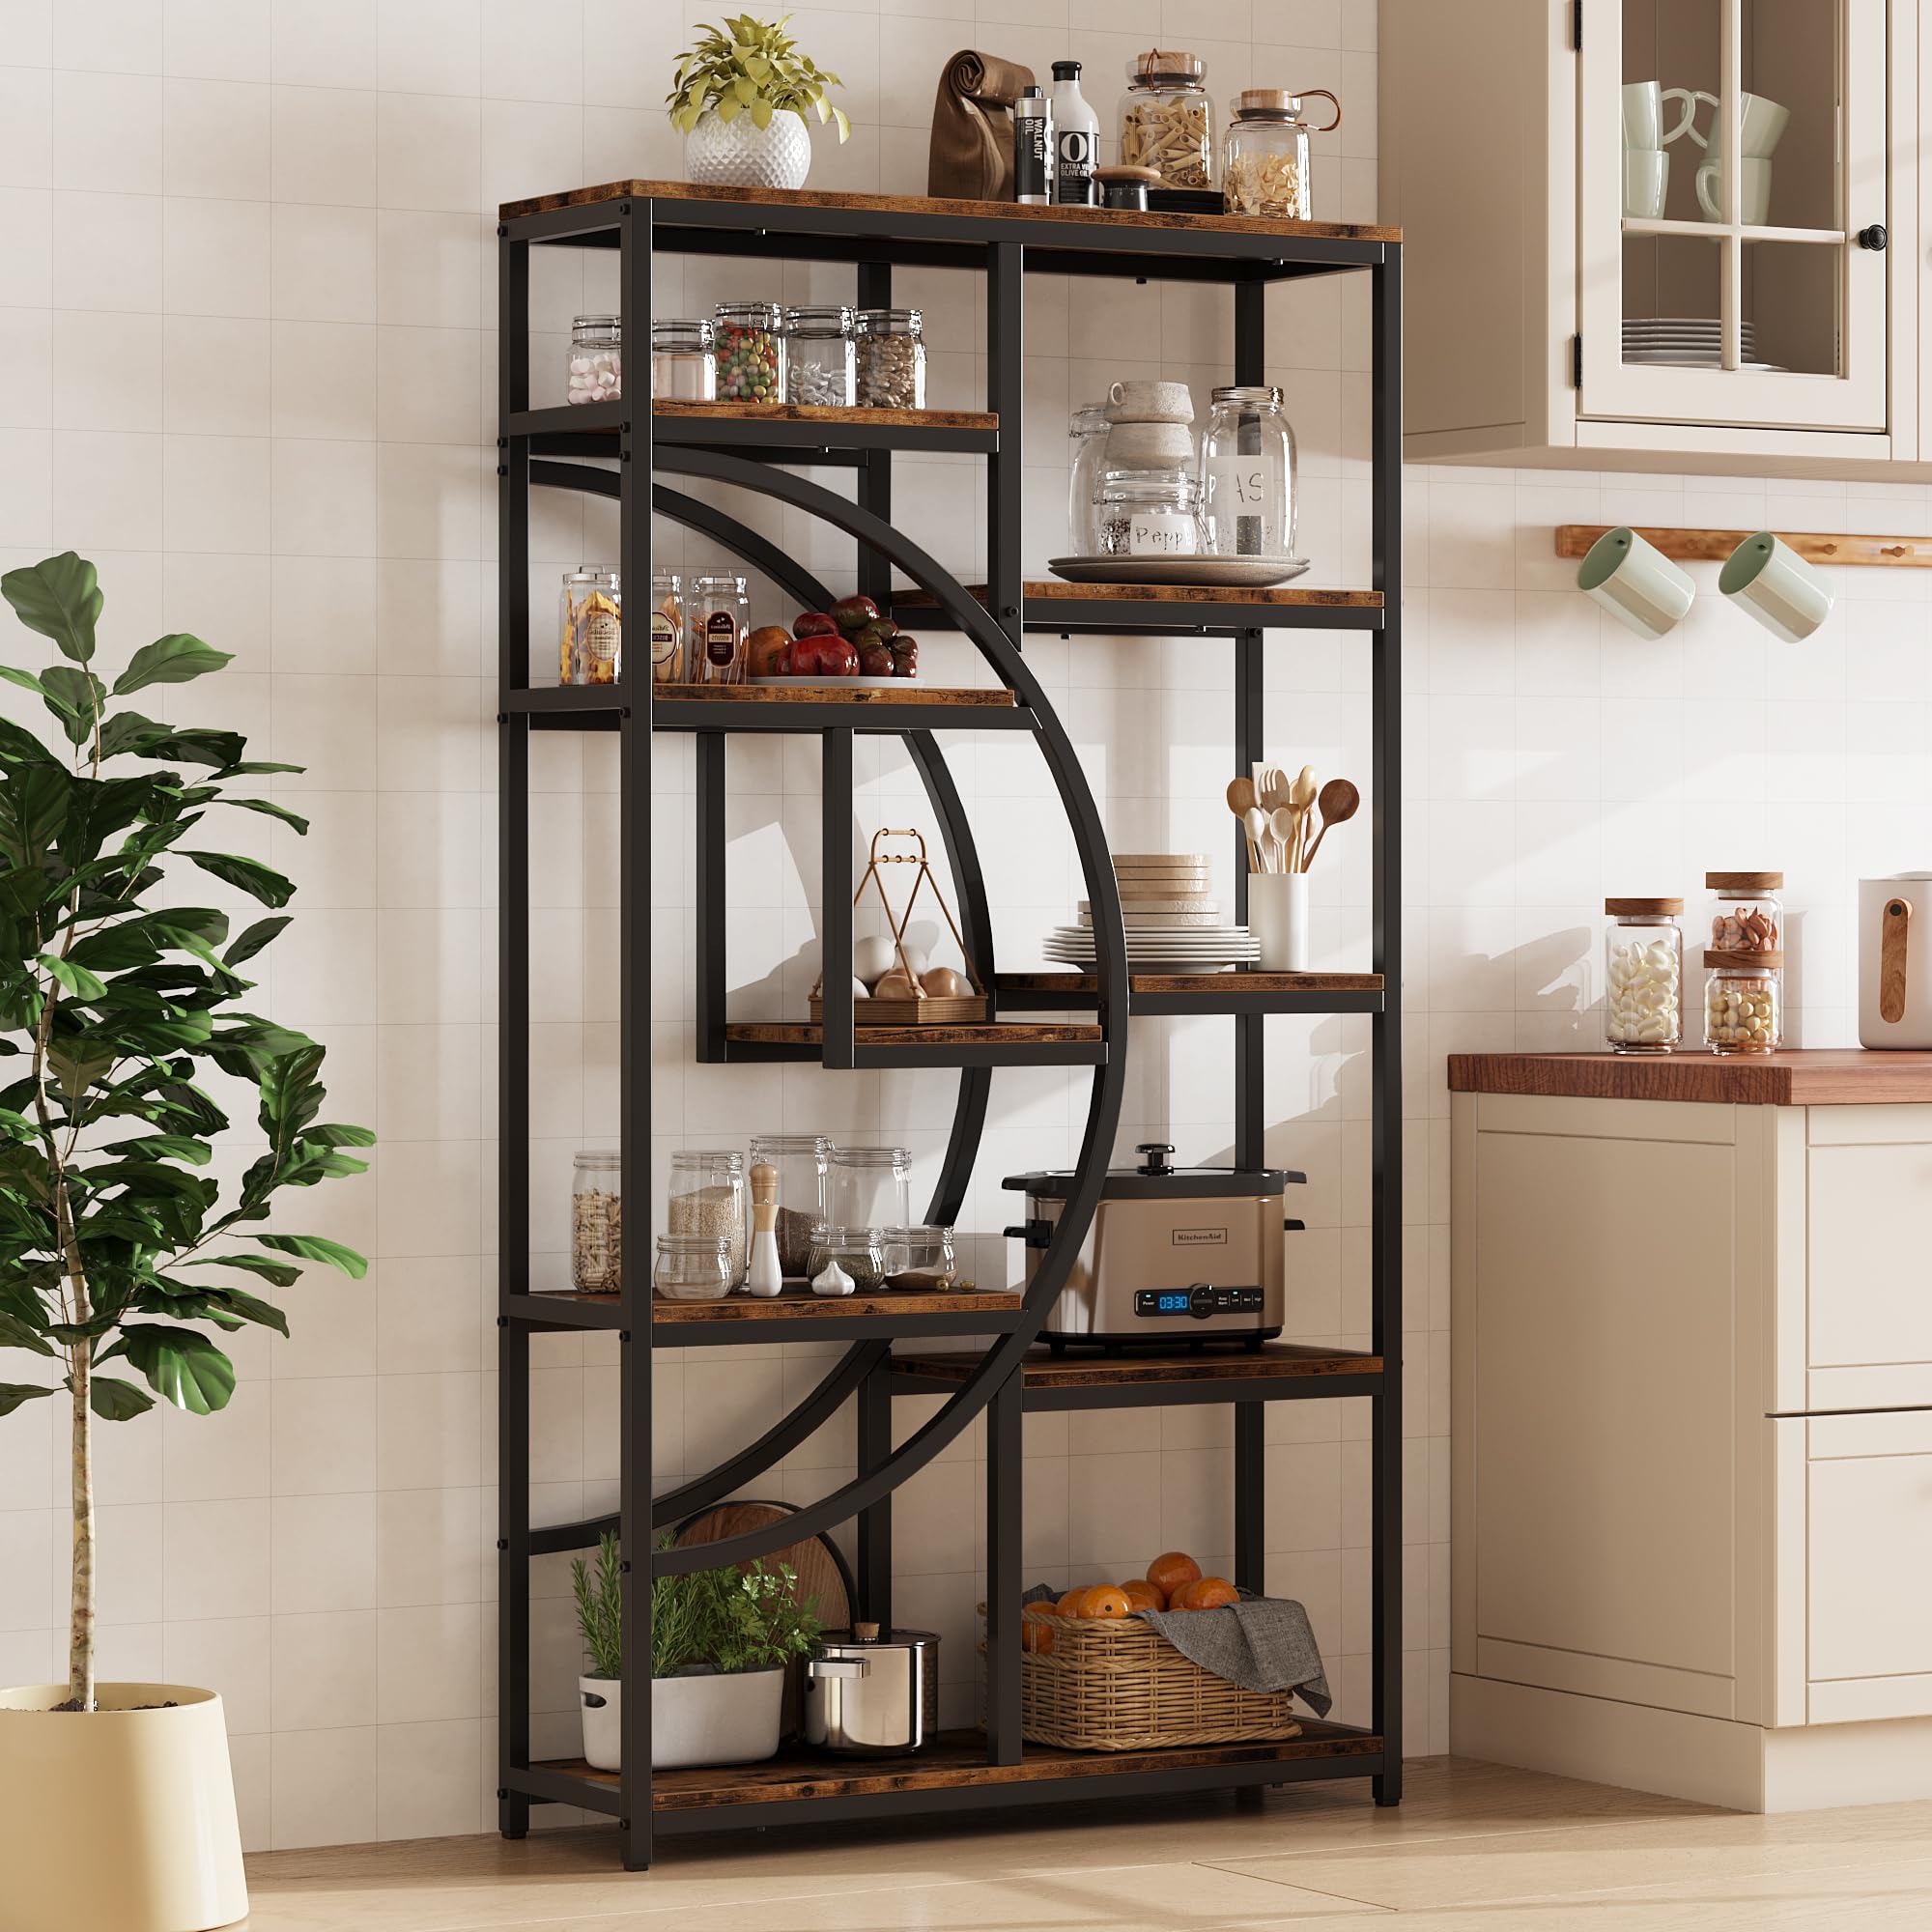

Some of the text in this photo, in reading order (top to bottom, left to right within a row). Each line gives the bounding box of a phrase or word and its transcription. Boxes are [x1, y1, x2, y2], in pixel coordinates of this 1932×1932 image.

[1025, 119, 1035, 135] OIL
[1034, 119, 1043, 160] WALNUT
[1159, 1296, 1188, 1309] 03:30
